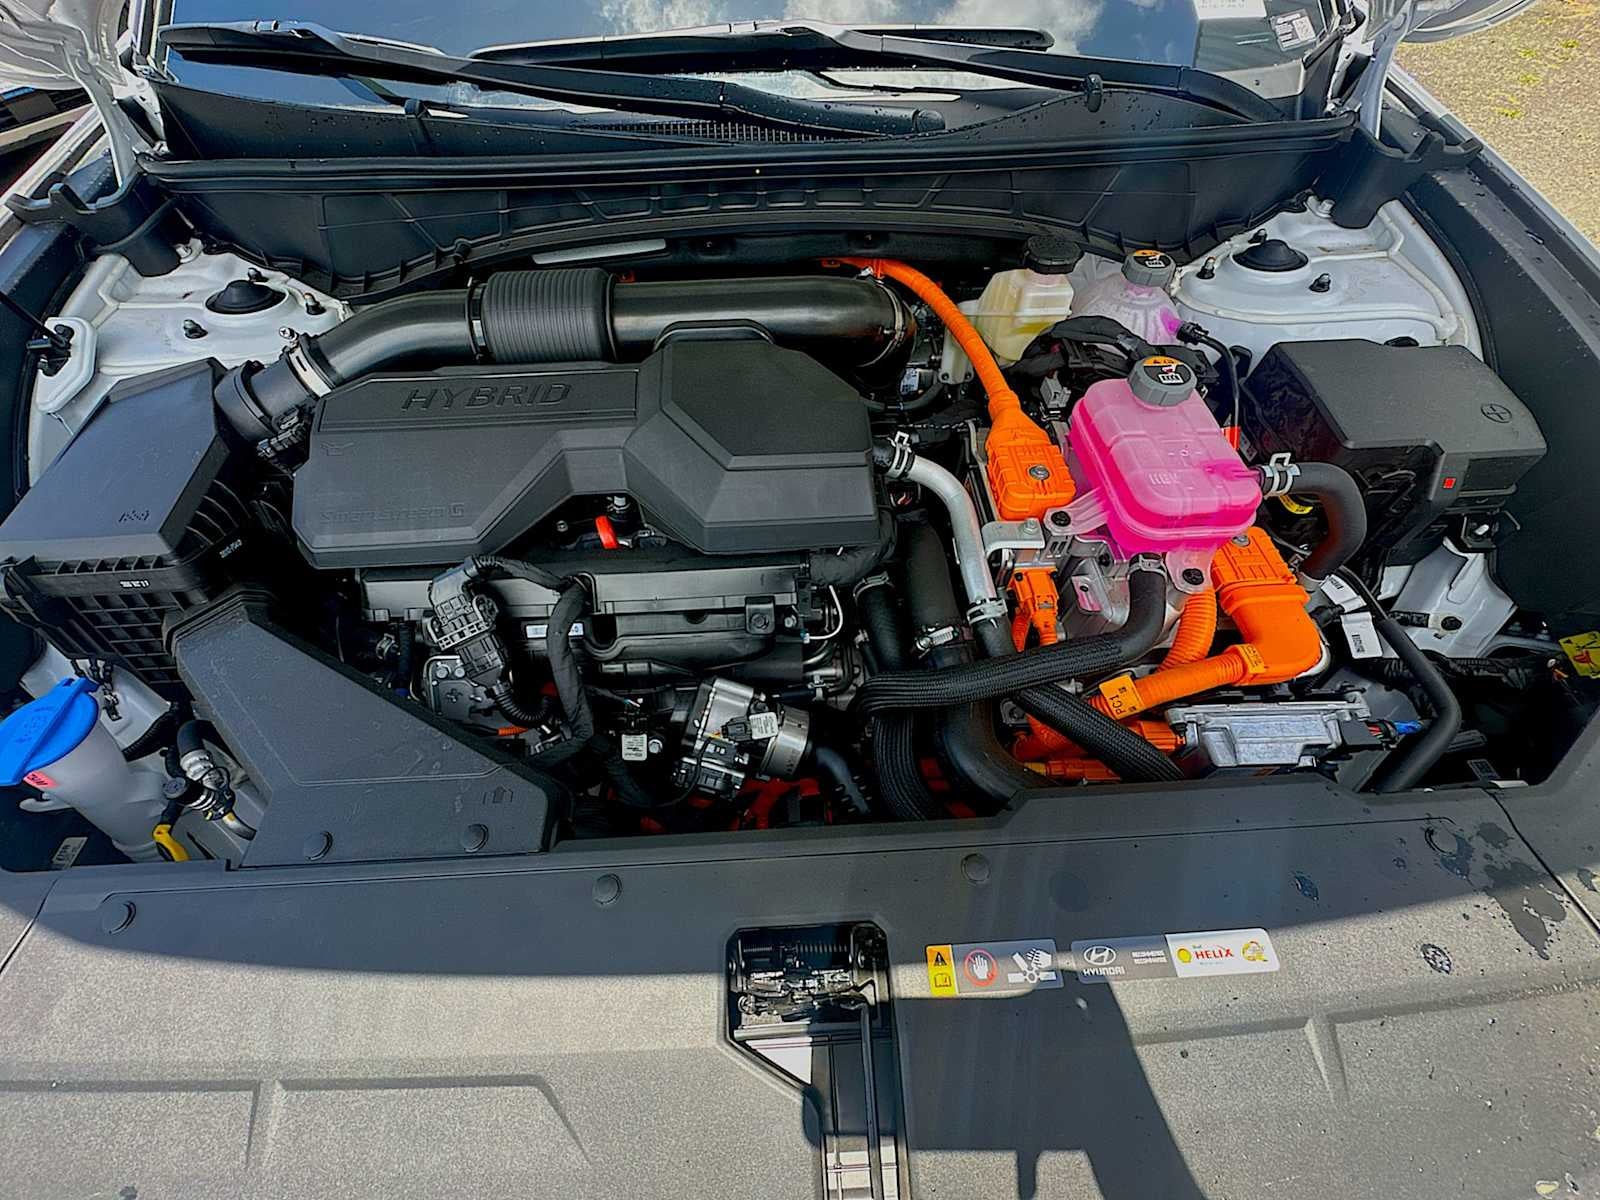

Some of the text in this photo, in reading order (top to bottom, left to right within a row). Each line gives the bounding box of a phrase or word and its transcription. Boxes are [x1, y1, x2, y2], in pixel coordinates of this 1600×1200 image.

[402, 384, 572, 411] HYBRID
[1195, 947, 1234, 960] HELIX
[1082, 966, 1126, 977] HYUNDAI
